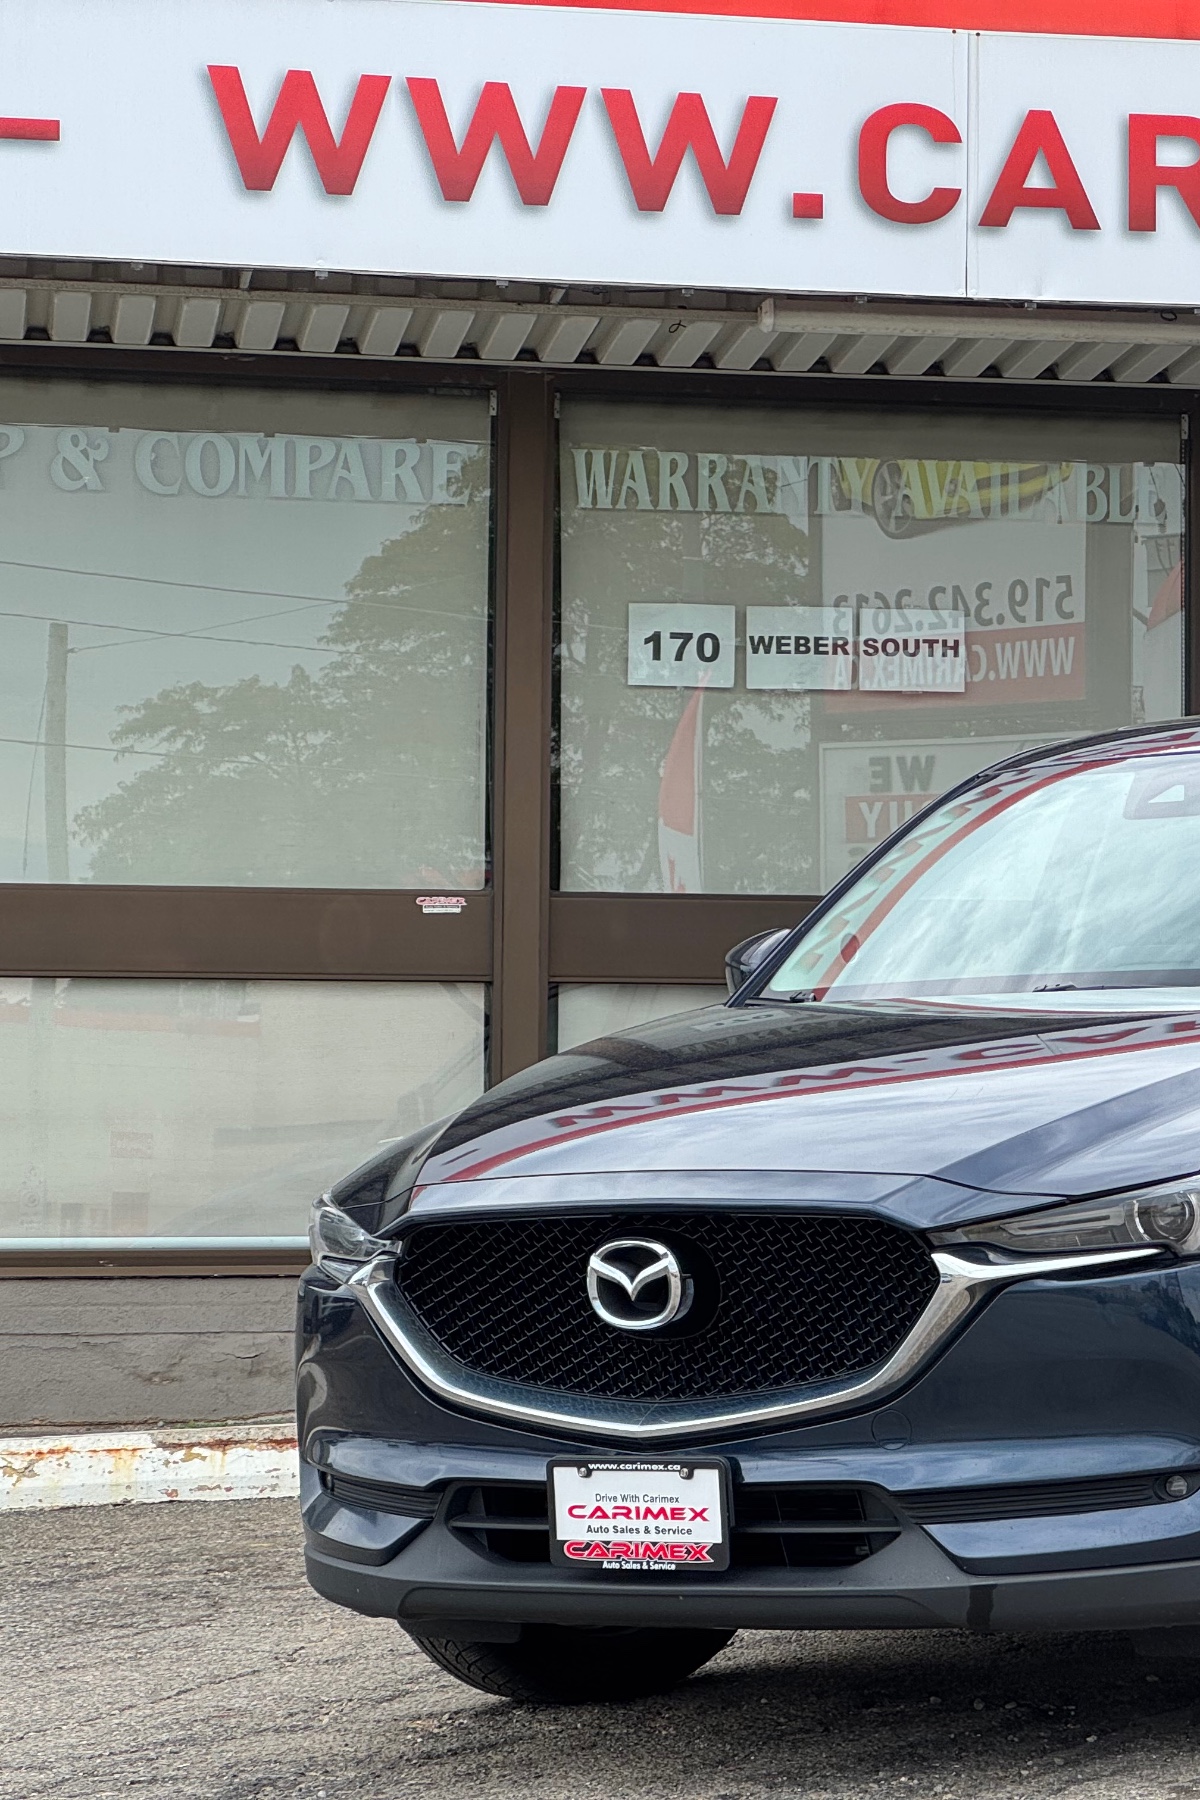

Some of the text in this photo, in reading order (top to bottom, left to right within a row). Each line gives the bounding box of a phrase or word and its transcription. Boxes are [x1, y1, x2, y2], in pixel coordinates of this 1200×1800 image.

[50, 427, 110, 492] &
[134, 431, 470, 506] COMPARE
[571, 448, 1168, 525] WARRANTY AVAILABLE
[643, 631, 960, 663] 170 WEBER SOUTH
[587, 1461, 681, 1472] www.carimex.ca
[595, 1493, 680, 1504] Drive With Carimex
[567, 1504, 710, 1522] CARIMEX
[586, 1524, 693, 1536] Auto Sales & Service
[564, 1540, 714, 1563] CARIMEX
[602, 1561, 676, 1571] Auto Sales & Service
